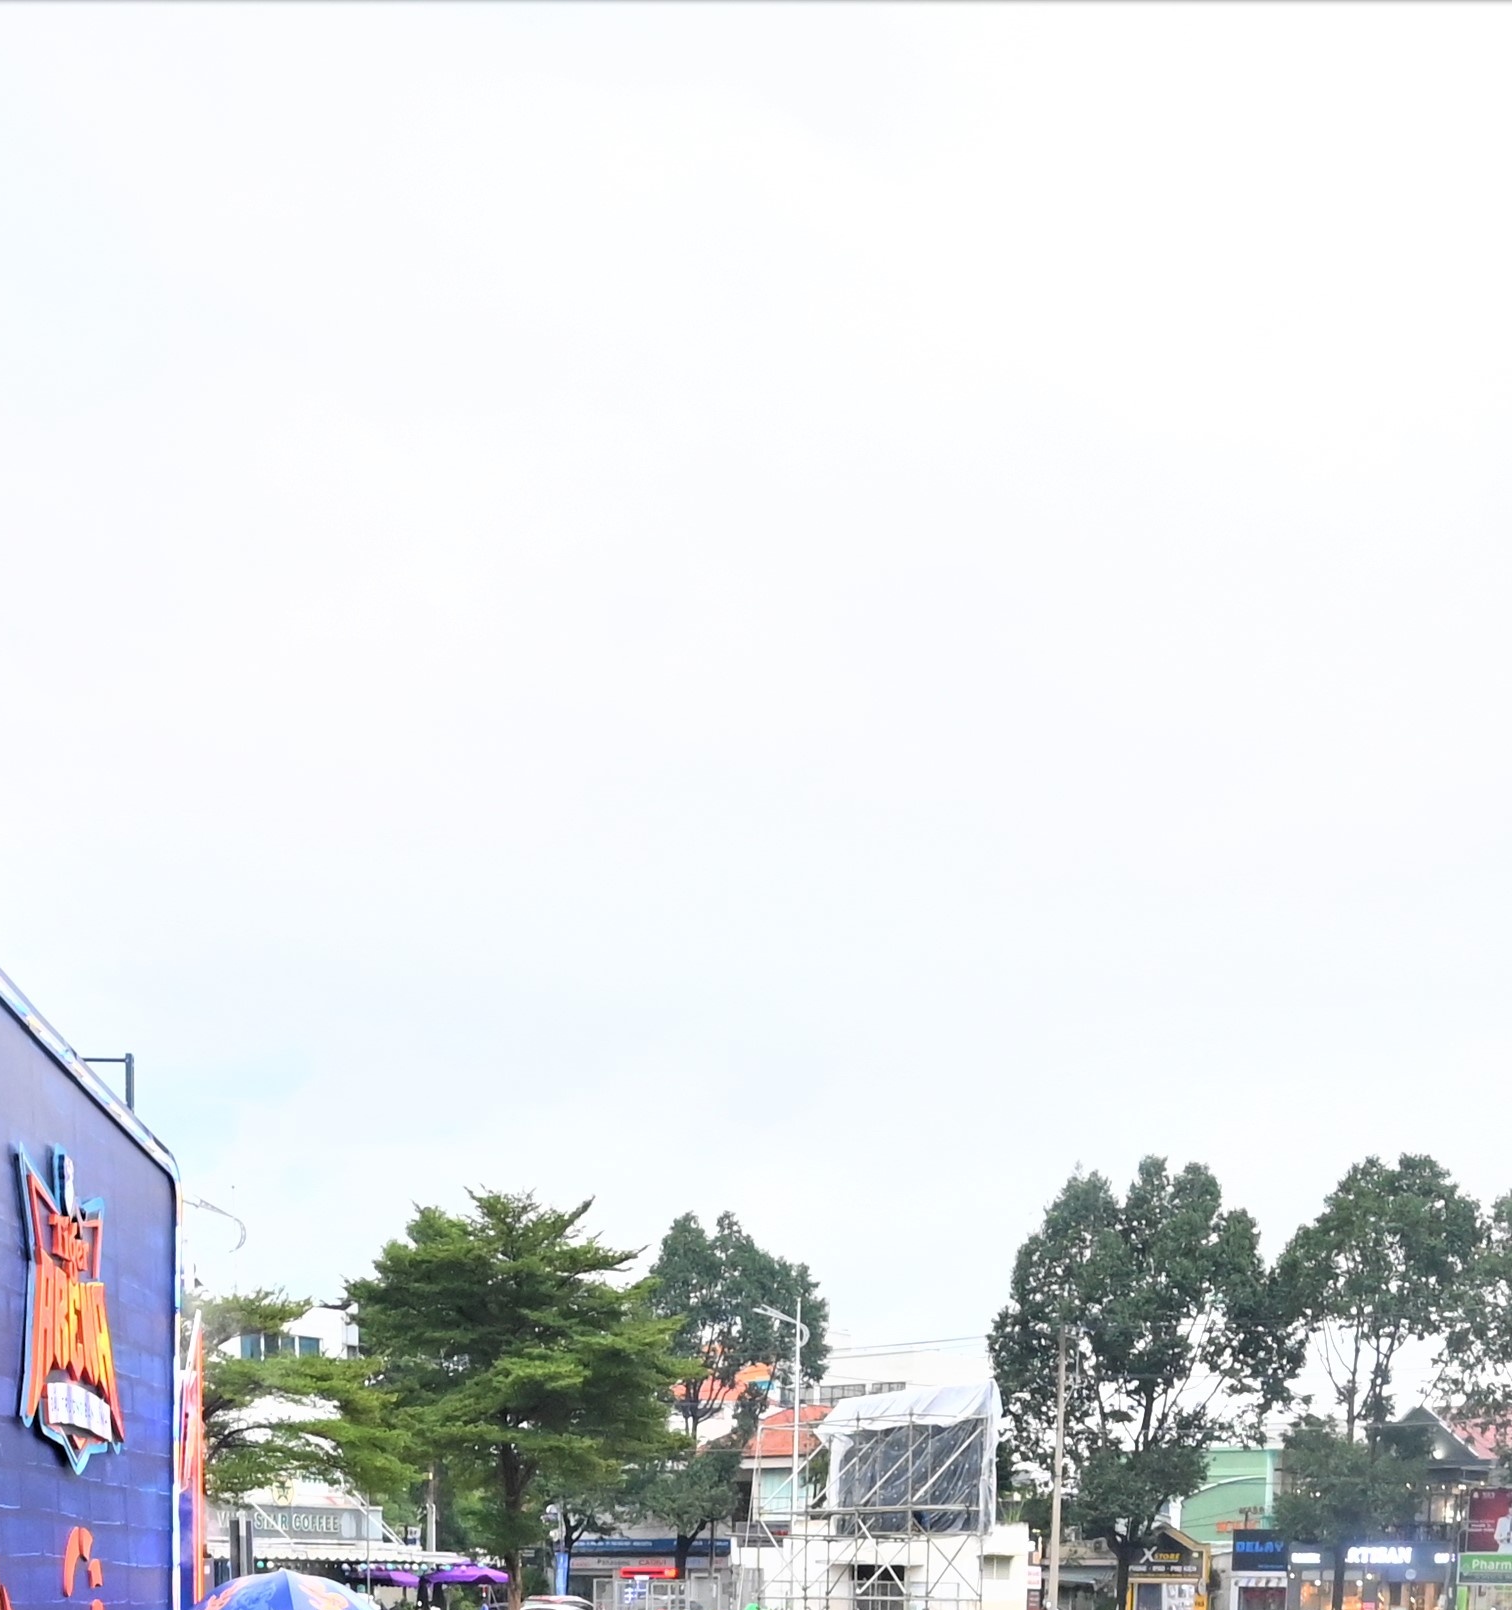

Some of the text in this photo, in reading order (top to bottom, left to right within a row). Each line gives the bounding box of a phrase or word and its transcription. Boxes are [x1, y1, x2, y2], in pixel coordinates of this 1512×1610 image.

[48, 1213, 89, 1284] Tiger
[26, 1247, 125, 1442] ARENA
[254, 1512, 288, 1530] STAR
[292, 1513, 338, 1532] COFFEE
[1235, 1541, 1284, 1554] DELAY
